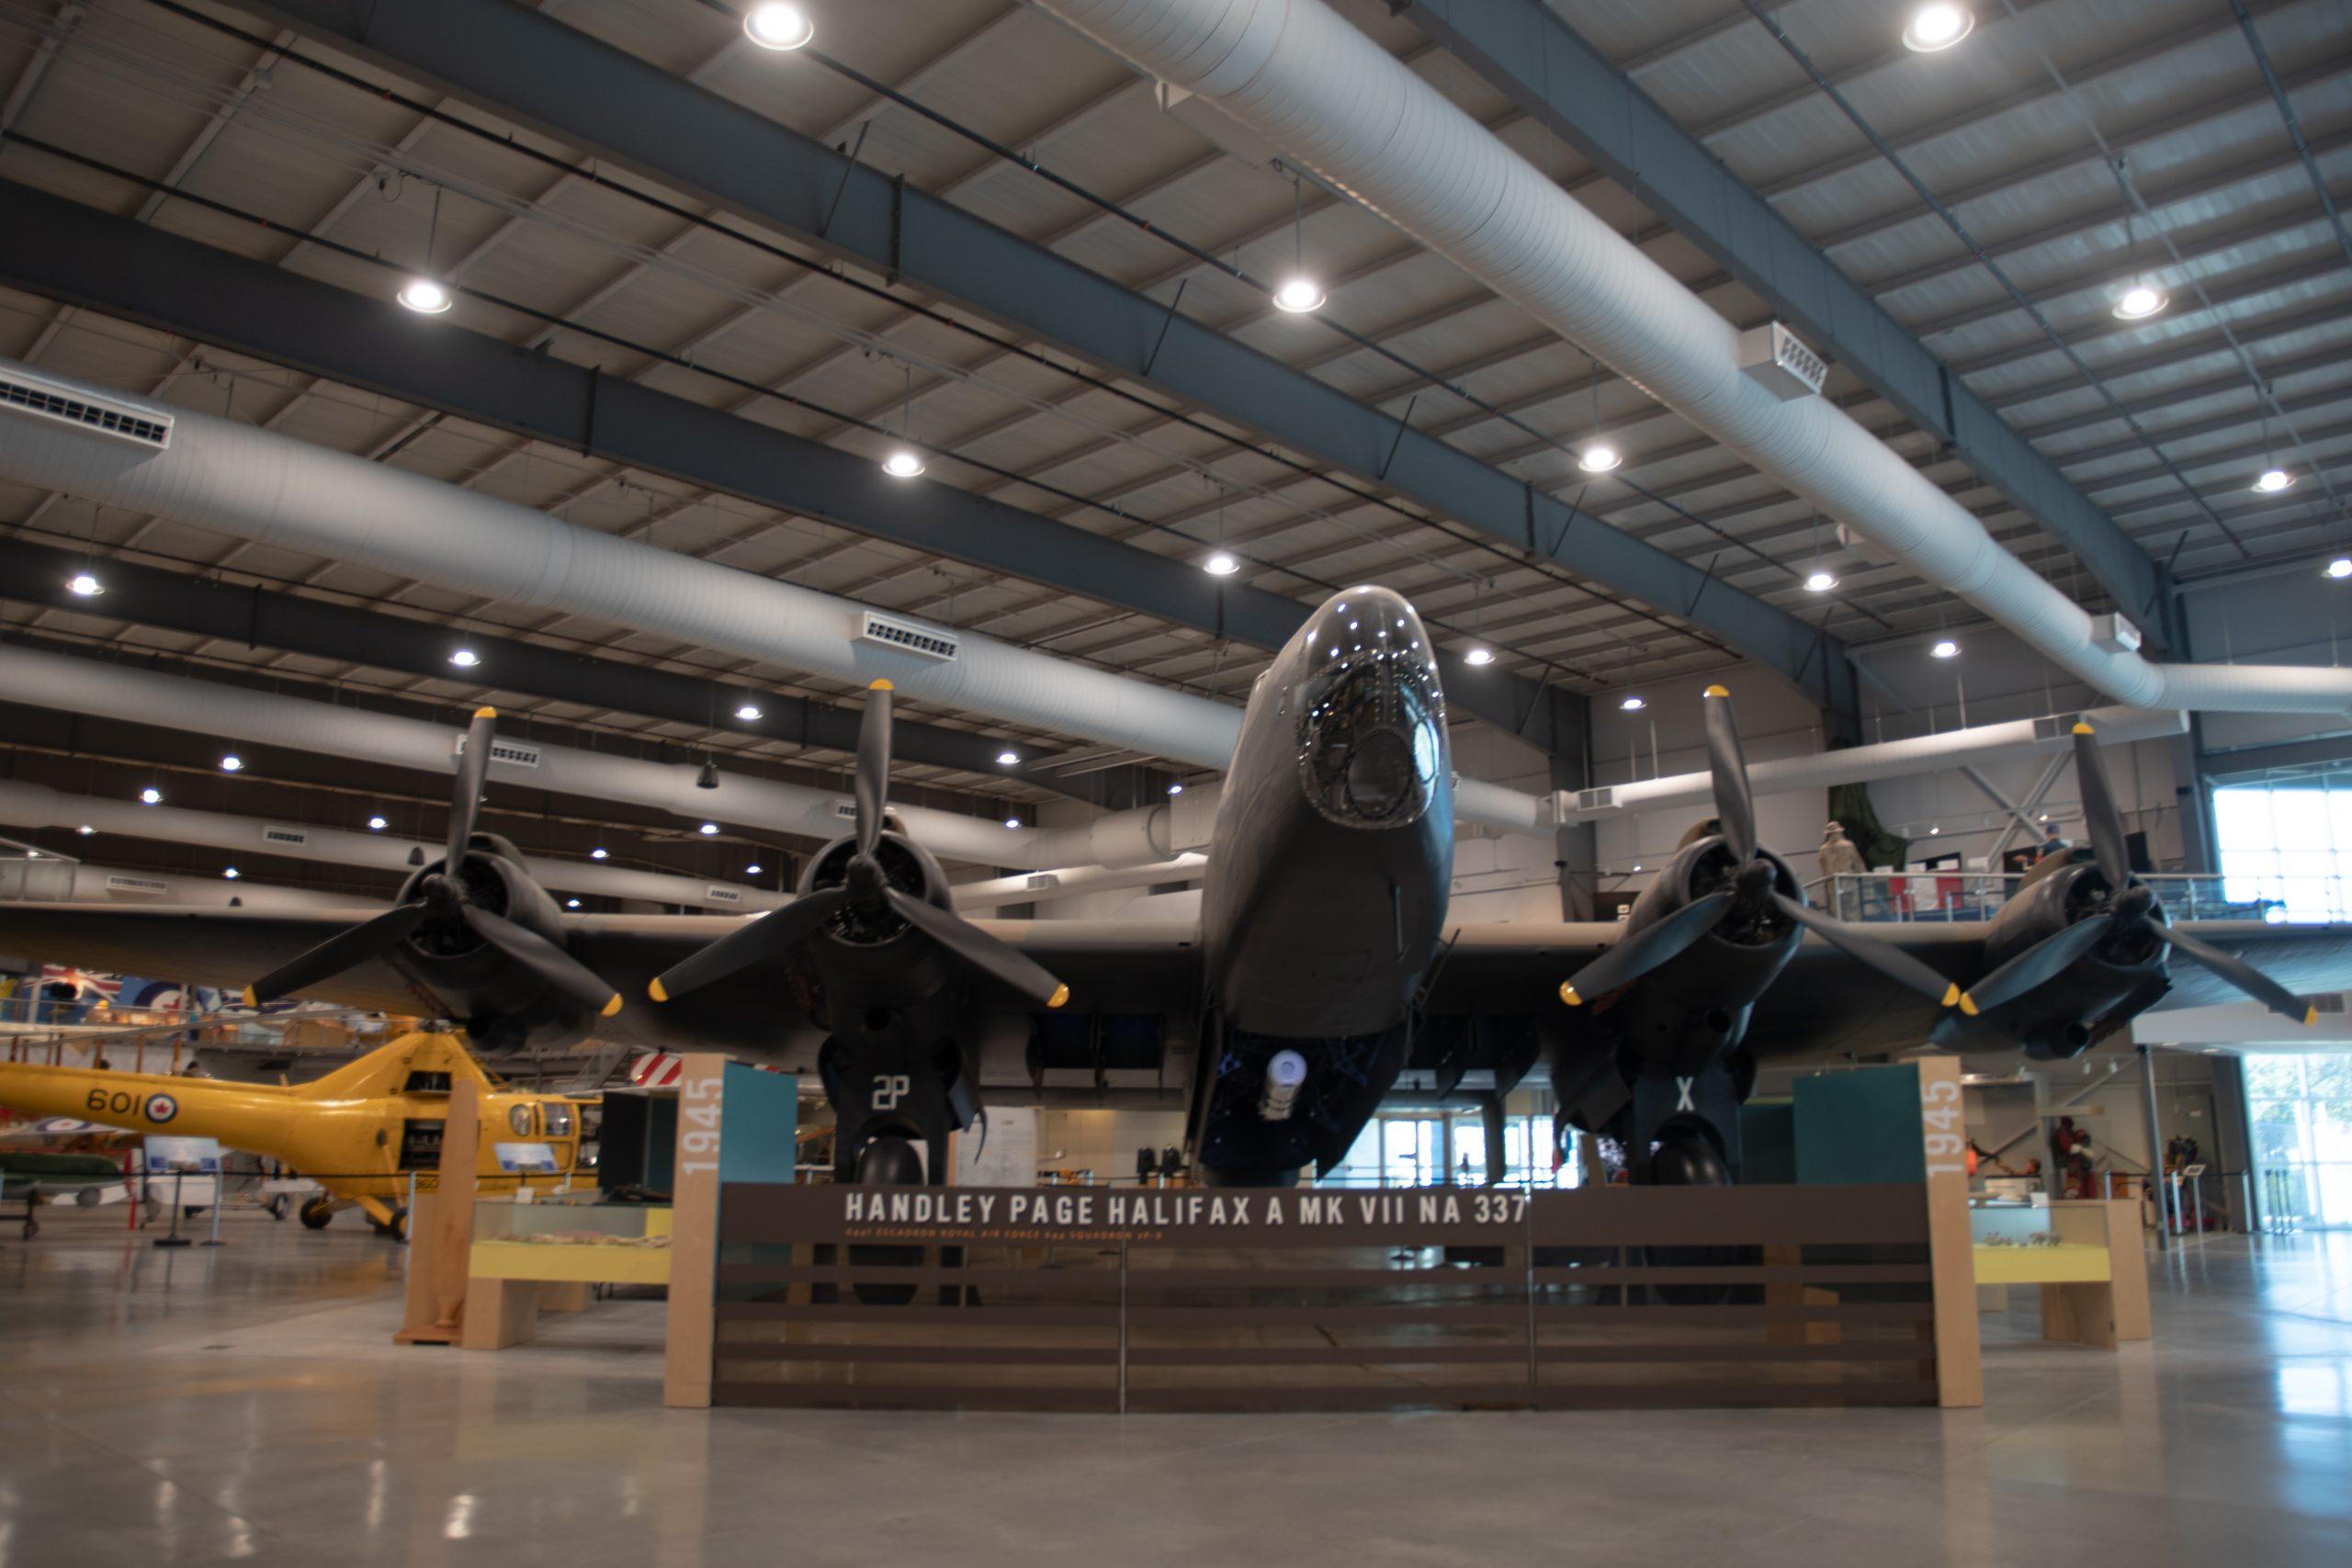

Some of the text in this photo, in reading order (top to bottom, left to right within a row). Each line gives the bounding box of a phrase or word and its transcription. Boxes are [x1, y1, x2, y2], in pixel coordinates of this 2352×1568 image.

[86, 1089, 141, 1116] 601
[873, 1075, 910, 1110] 2P
[1676, 1077, 1694, 1111] X
[683, 1077, 724, 1175] 1945
[1922, 1081, 1963, 1178] 1945
[845, 1193, 1526, 1225] HANDLEY PAGE HALIFAX A MK VII NA 337
